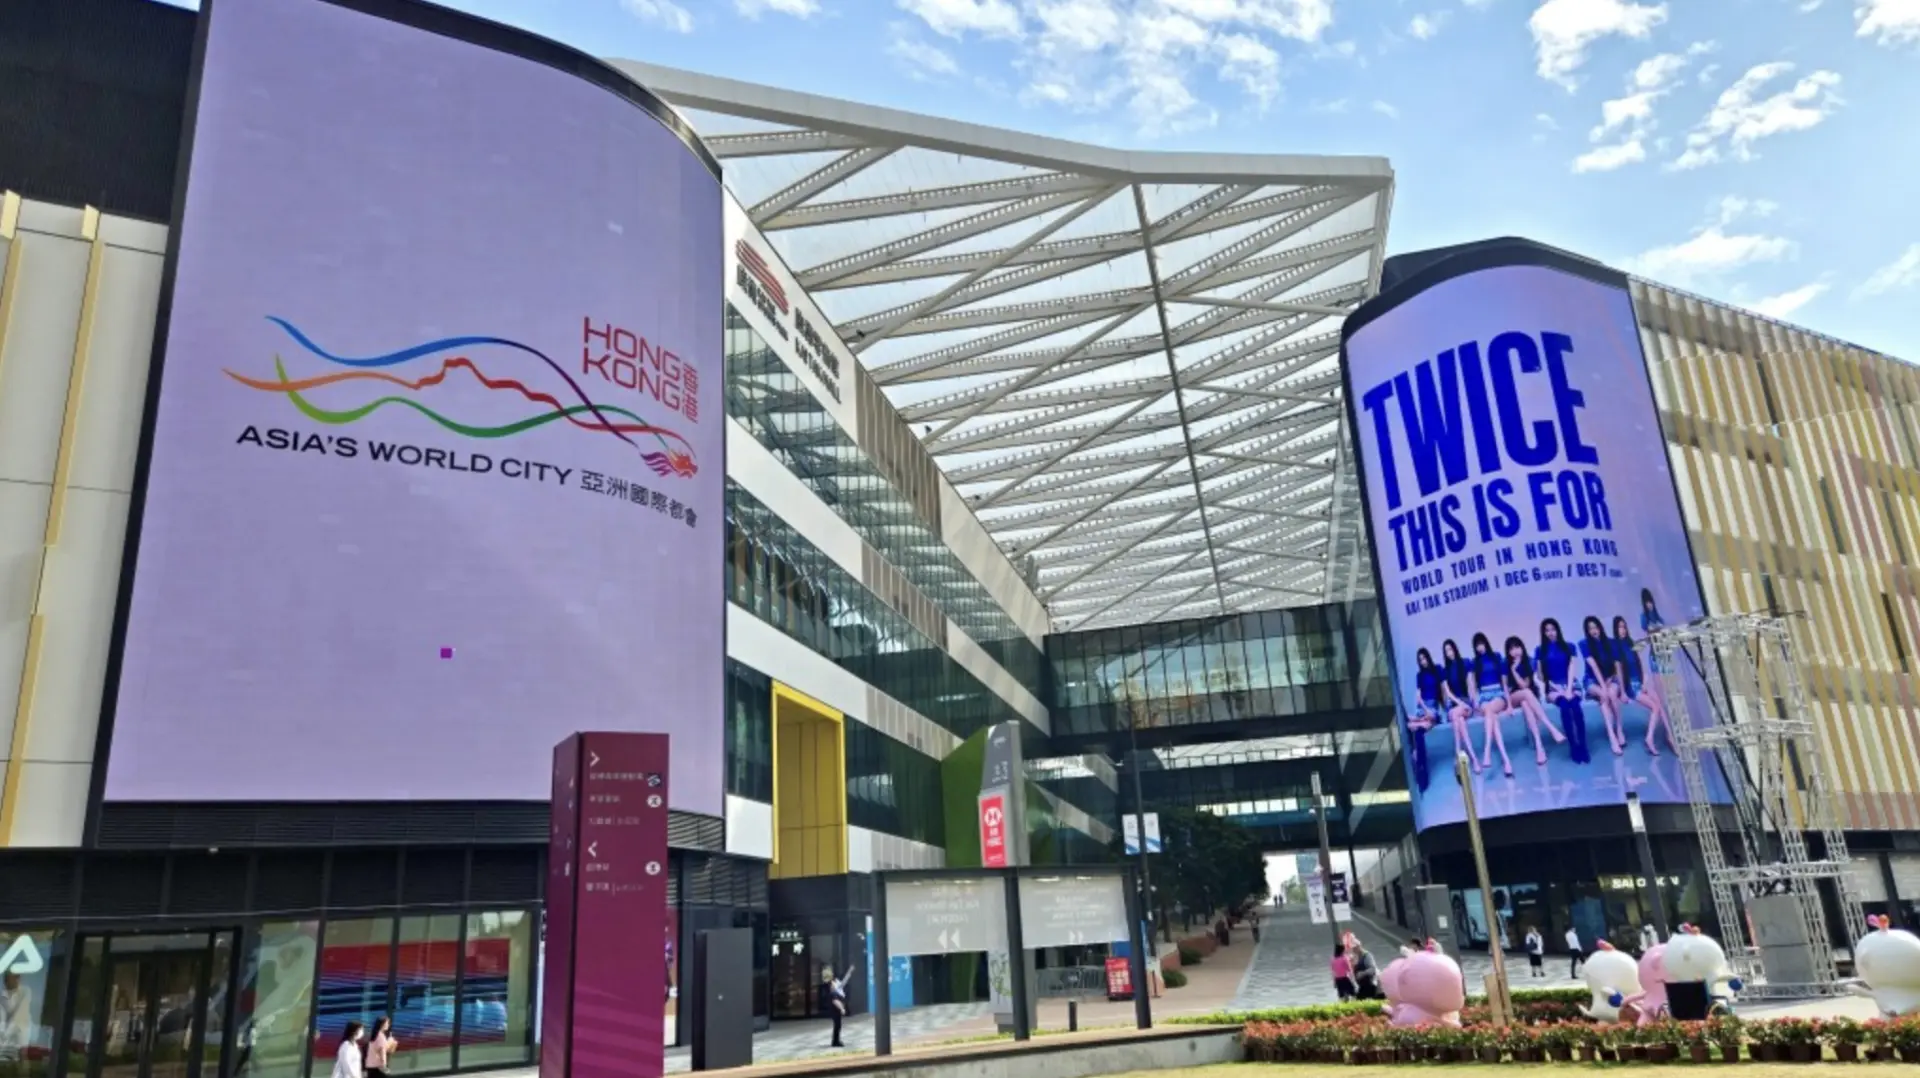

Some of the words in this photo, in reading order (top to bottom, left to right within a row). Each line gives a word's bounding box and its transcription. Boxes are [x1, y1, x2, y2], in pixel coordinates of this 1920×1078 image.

[583, 316, 681, 382] HONG
[583, 346, 681, 411] KONG
[1362, 330, 1599, 511] TWICE
[236, 425, 359, 457] ASIA'S
[368, 441, 493, 474] WORLD
[500, 458, 573, 486] CITY
[580, 468, 699, 529] 亞洲國際都會
[1388, 493, 1467, 573] THIS
[1471, 477, 1520, 544] IS
[1527, 469, 1613, 532] FOR
[1401, 568, 1444, 596] WORLD
[1450, 553, 1487, 580] TOUR
[1495, 547, 1514, 566] IN
[1524, 539, 1573, 561] HONG
[1582, 538, 1619, 558] KONG
[1442, 578, 1490, 605] STADIUM
[1504, 567, 1530, 588] DEC
[1532, 566, 1542, 582] 6
[1577, 562, 1600, 578] DEC
[1600, 563, 1607, 577] 7
